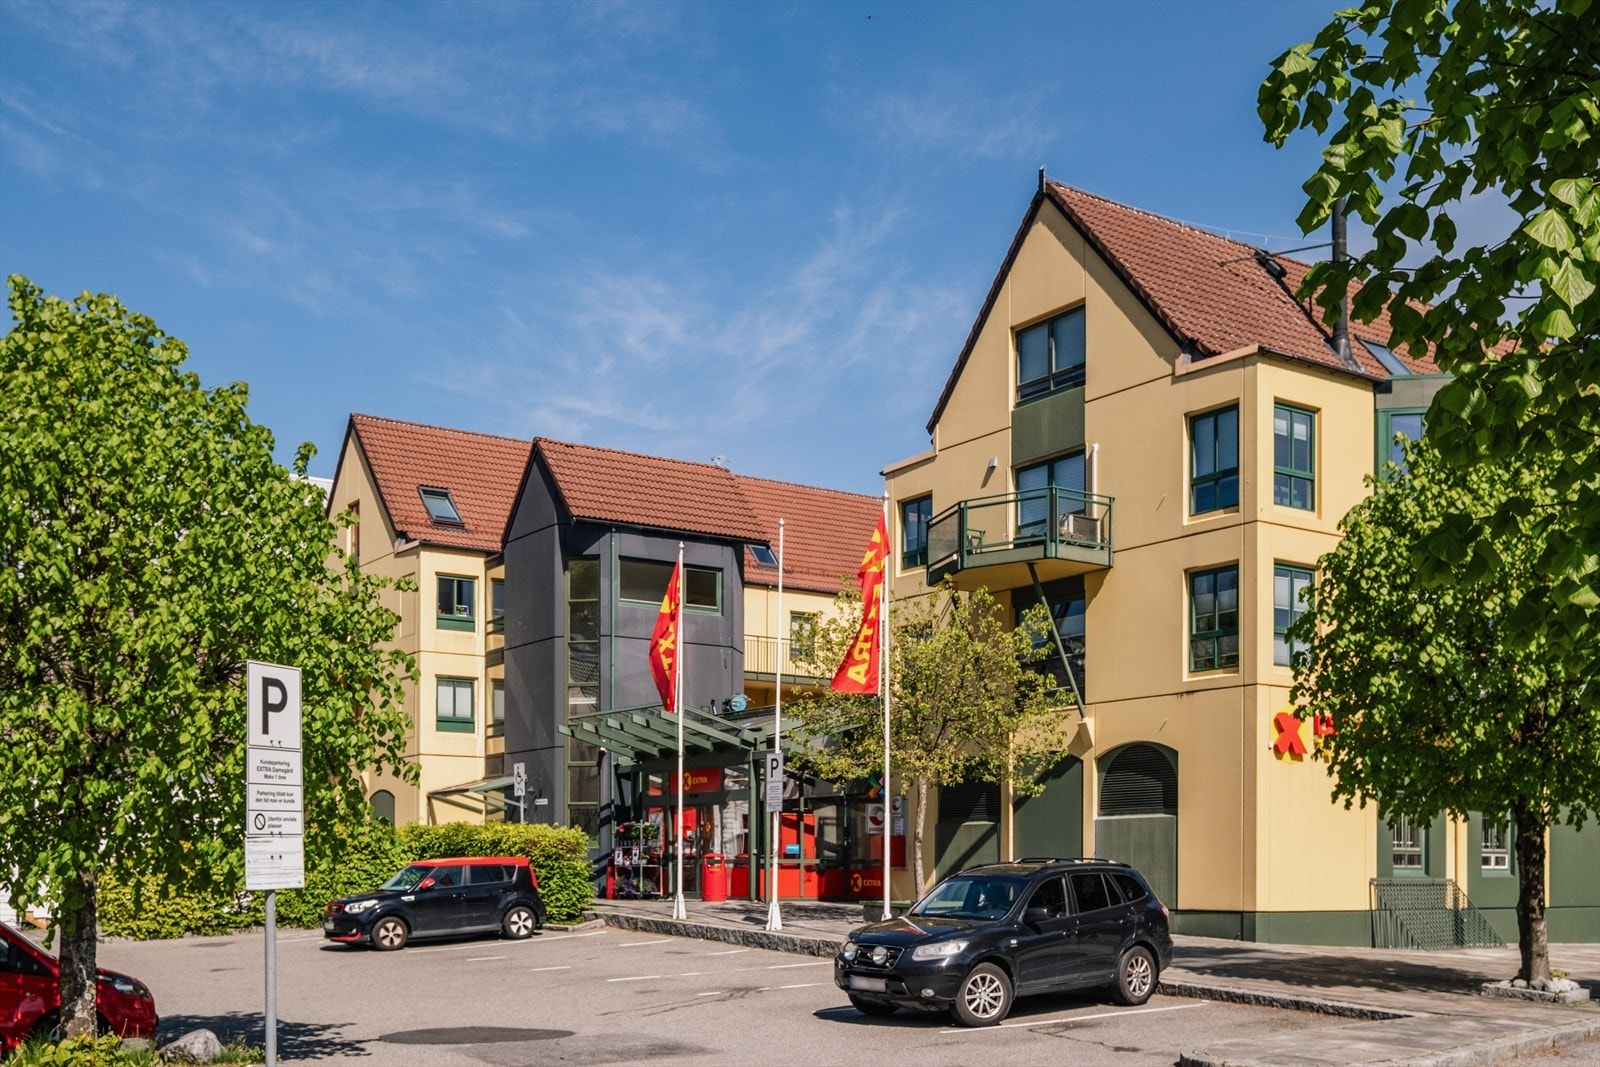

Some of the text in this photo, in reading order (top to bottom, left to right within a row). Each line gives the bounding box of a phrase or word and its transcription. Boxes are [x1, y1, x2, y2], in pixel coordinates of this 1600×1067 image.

[262, 676, 288, 735] P
[260, 759, 290, 767] Kundeparkering
[771, 758, 779, 778] P
